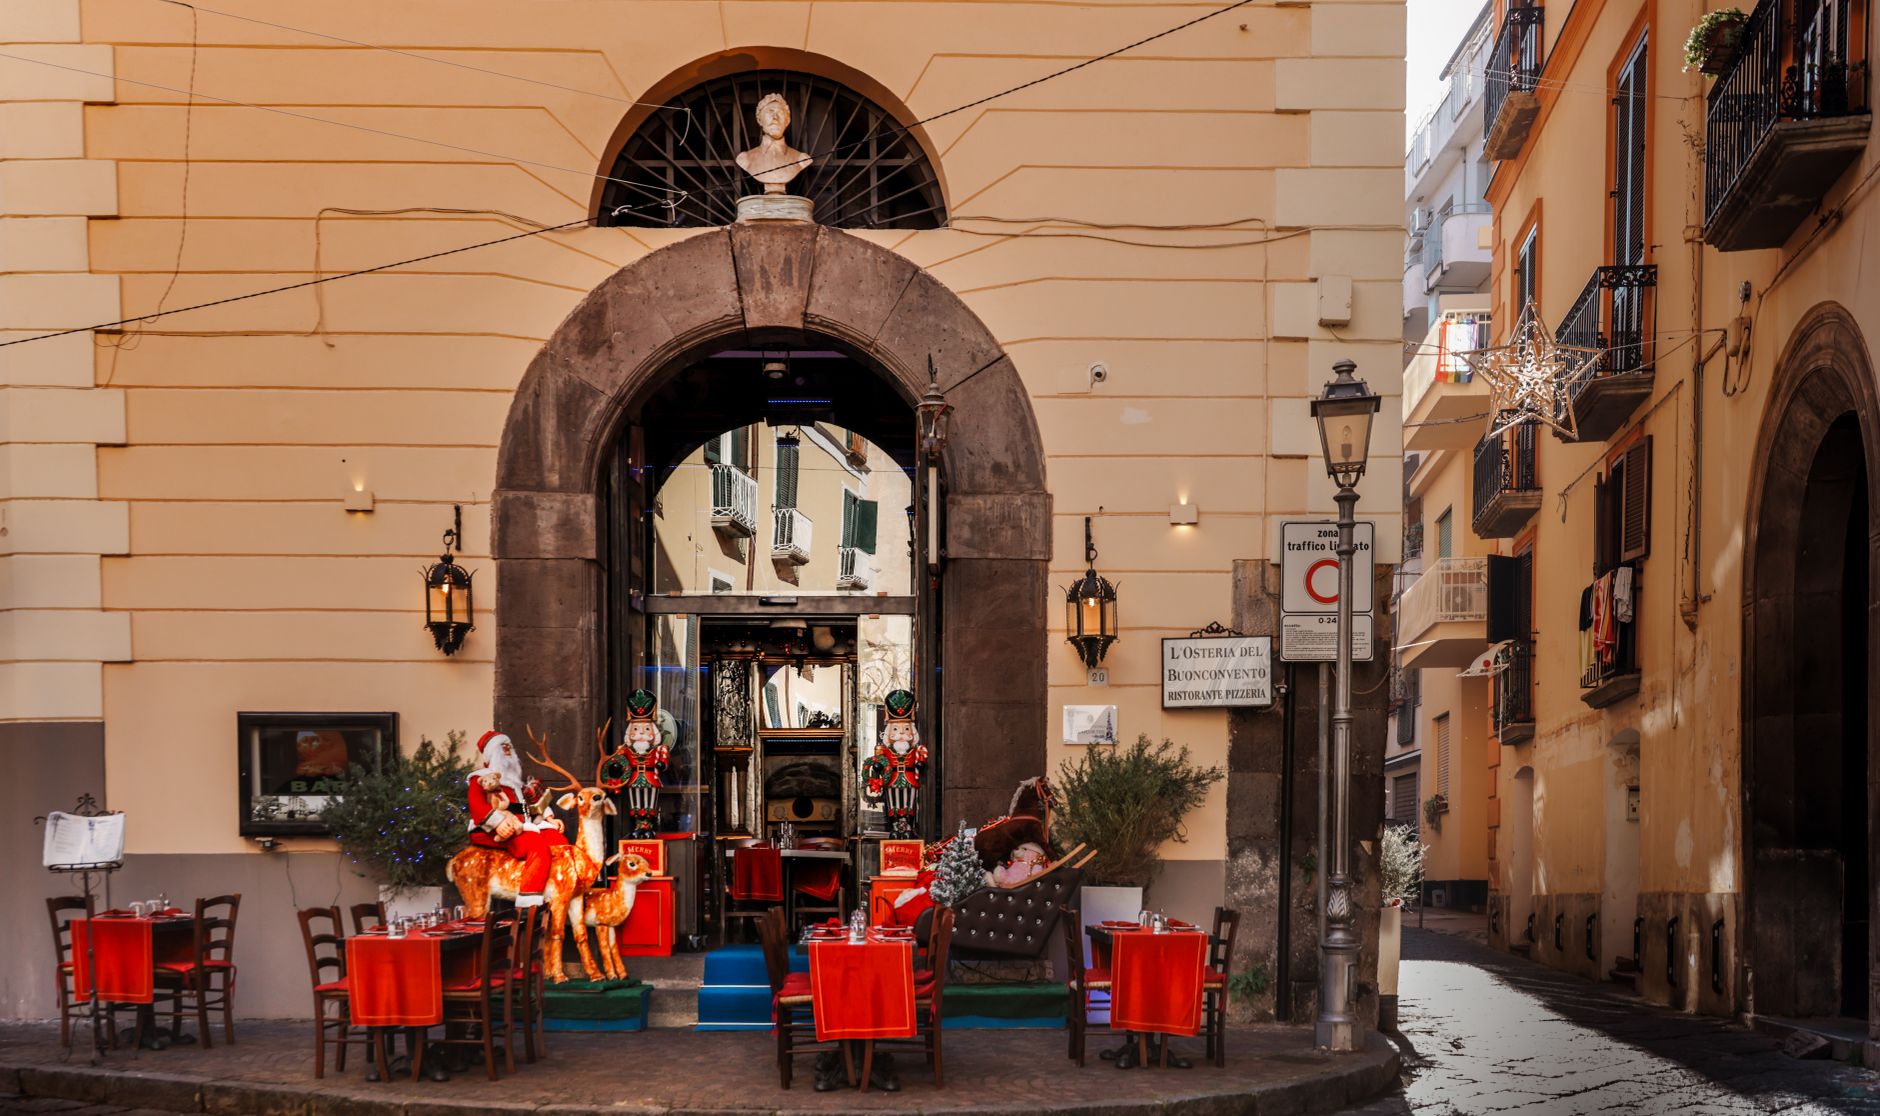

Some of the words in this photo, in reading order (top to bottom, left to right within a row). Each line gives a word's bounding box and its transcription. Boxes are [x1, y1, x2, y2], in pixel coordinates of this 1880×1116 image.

[1317, 529, 1339, 538] zona
[1287, 540, 1326, 551] traffico
[1329, 540, 1370, 551] liato
[1170, 646, 1236, 660] L'OSTERIA
[1240, 646, 1263, 657] DEL
[1091, 672, 1105, 682] 20
[1167, 667, 1266, 682] BUONCONVENTO
[1168, 689, 1223, 701] RISTORANTE
[1225, 688, 1266, 700] PIZZERIA
[290, 780, 350, 793] BAR
